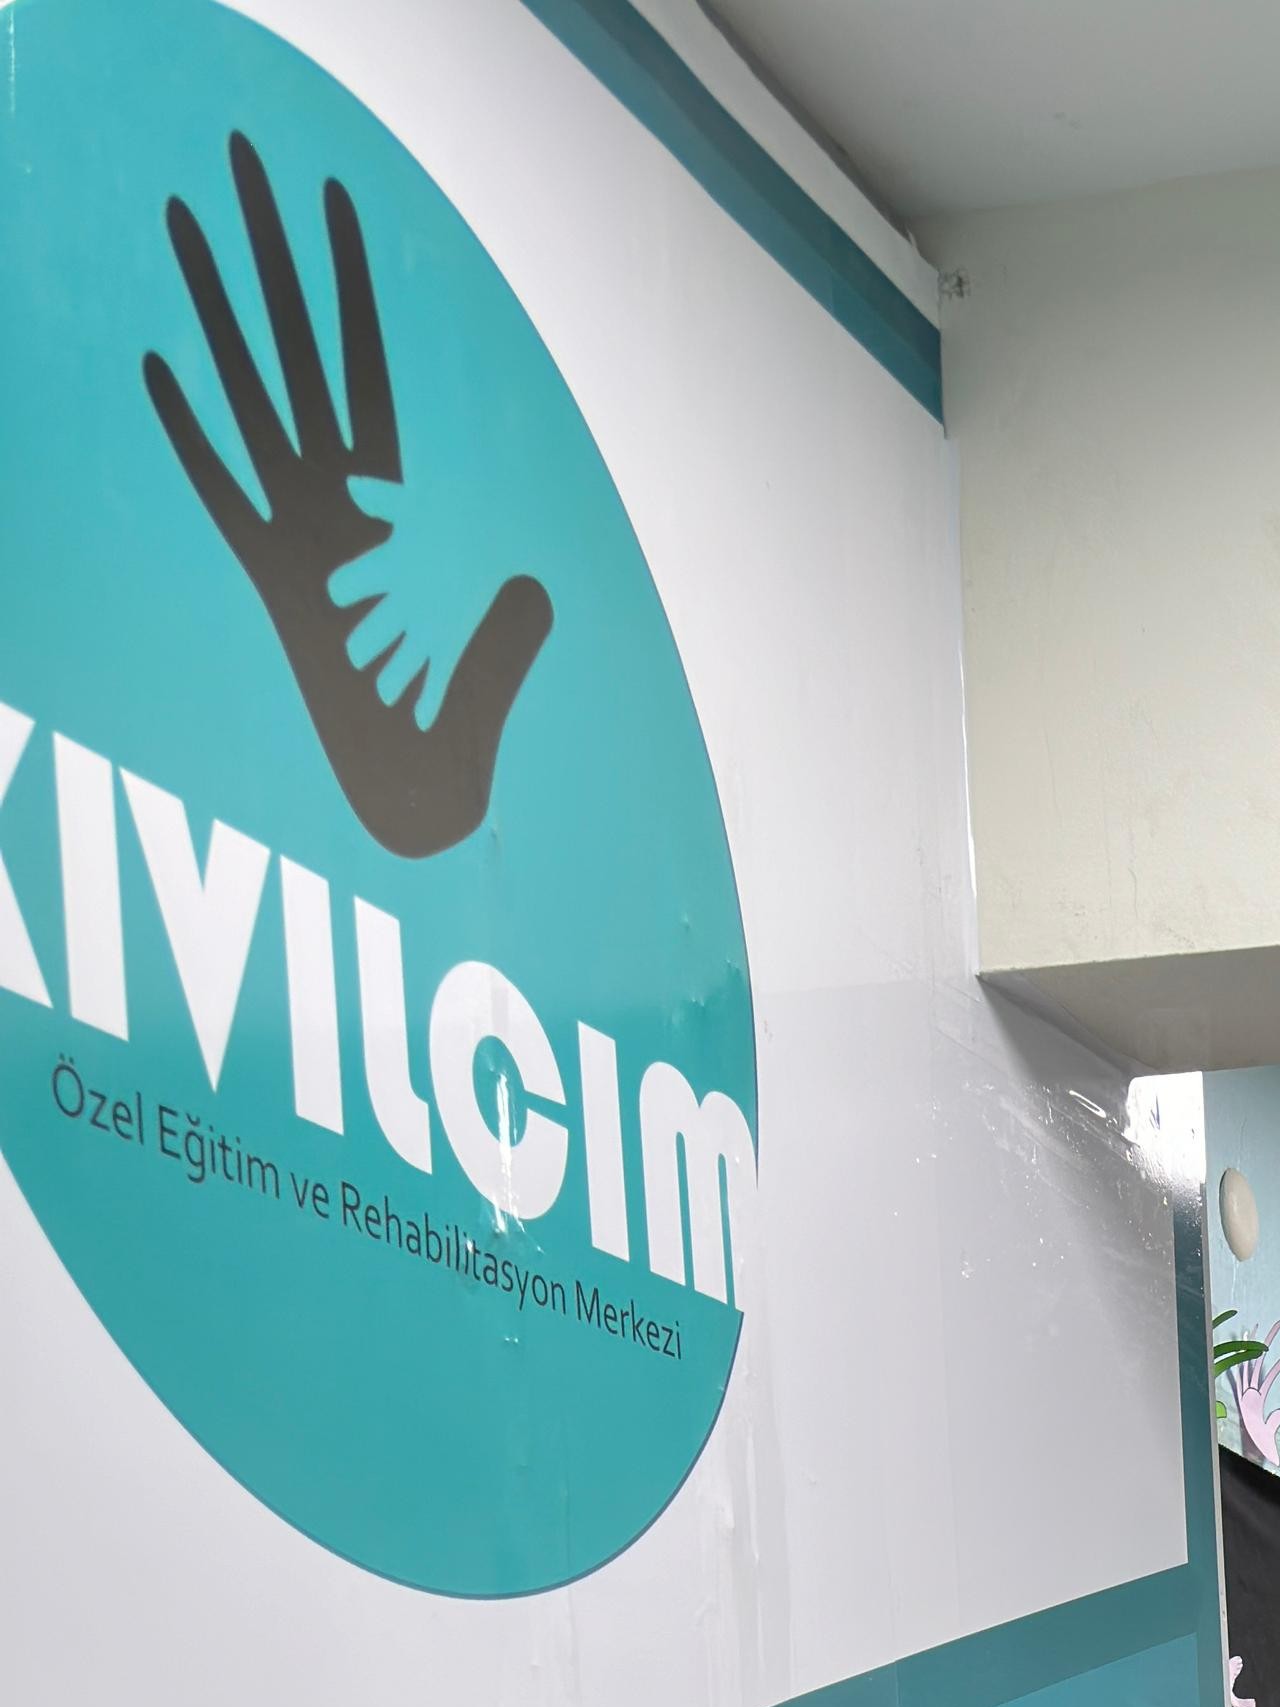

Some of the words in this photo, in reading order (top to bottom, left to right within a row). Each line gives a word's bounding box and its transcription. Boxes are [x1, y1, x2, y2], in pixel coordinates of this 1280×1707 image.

[52, 1053, 145, 1148] Özel
[158, 1102, 280, 1200] Eğitim
[290, 1171, 331, 1221] ve
[341, 1181, 569, 1317] Rehabilitasyon
[574, 1279, 684, 1361] Merkezi
